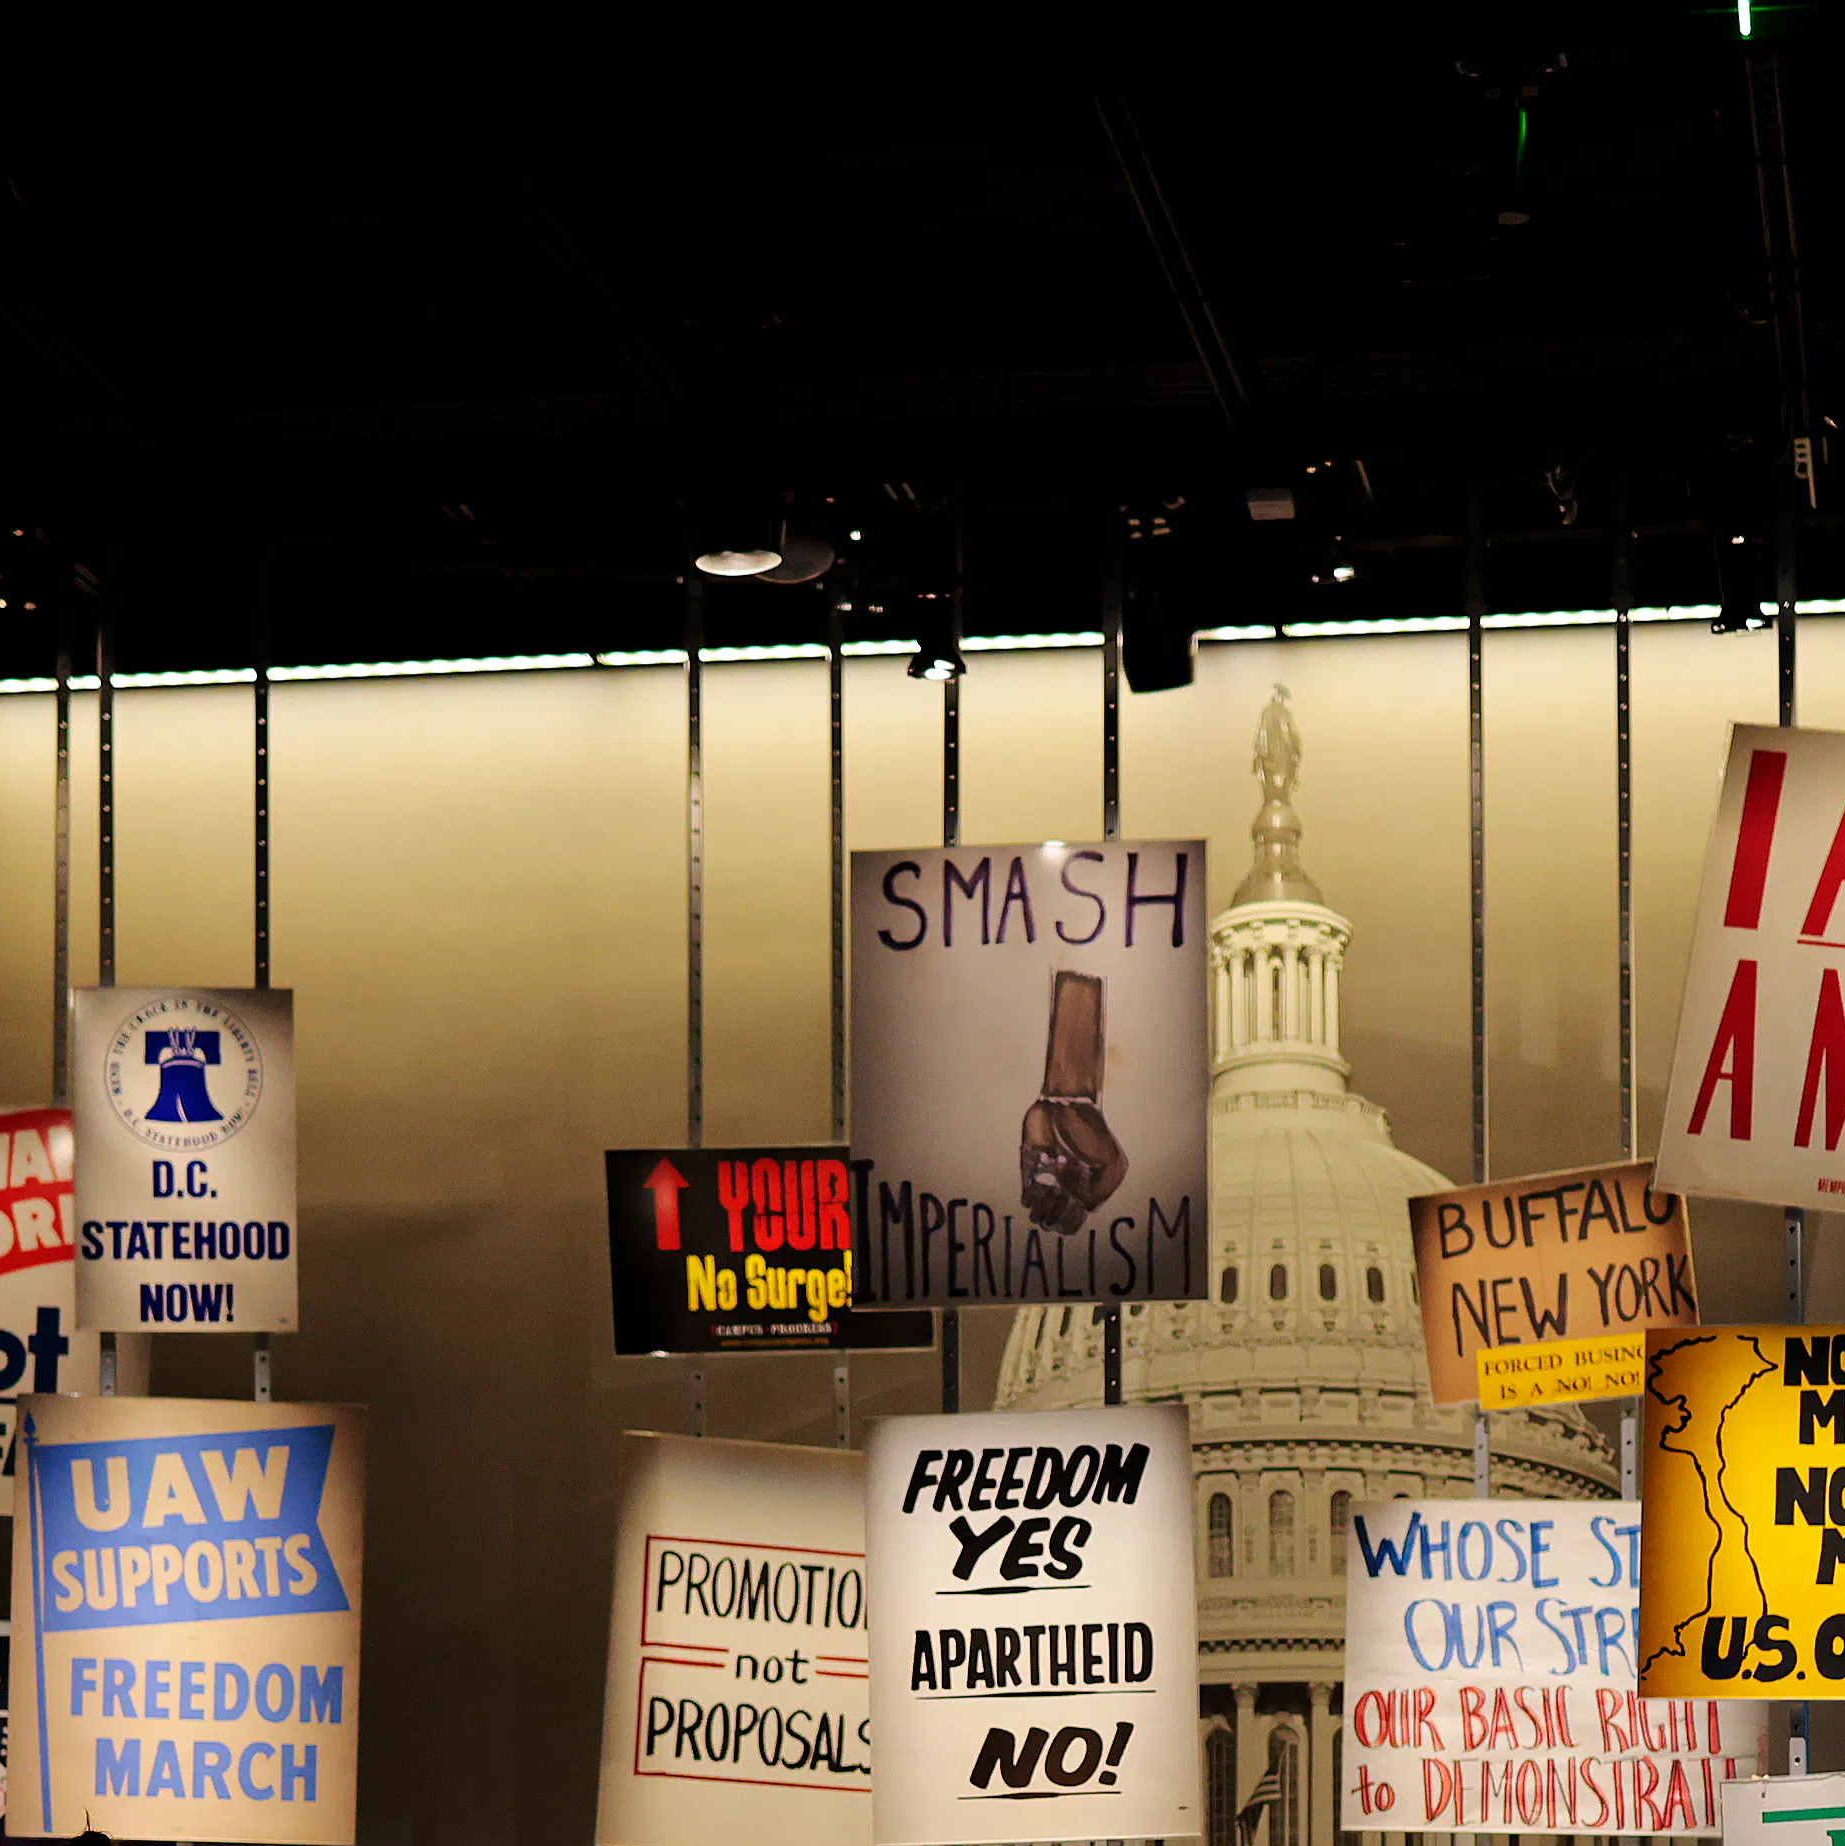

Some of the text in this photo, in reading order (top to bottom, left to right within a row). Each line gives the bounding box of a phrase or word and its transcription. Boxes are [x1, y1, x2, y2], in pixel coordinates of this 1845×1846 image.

[1724, 749, 1787, 930] I
[877, 851, 1188, 951] SMASH
[1687, 959, 1758, 1140] A
[153, 1161, 217, 1198] D.C.
[717, 1157, 851, 1252] YOUR
[82, 1221, 290, 1260] STATEHOOD
[850, 1158, 1191, 1301] IMPERIALISM
[1437, 1179, 1677, 1260] BUFFALO
[140, 1284, 234, 1322] NOW!
[686, 1249, 852, 1323] No Surge!
[1452, 1252, 1696, 1358] NEW YORK
[1484, 1353, 1563, 1376] FORCED
[1500, 1384, 1517, 1400] IS
[1531, 1382, 1544, 1398] A
[70, 1446, 290, 1532] UAW
[902, 1442, 1150, 1513] FREEDOM
[53, 1534, 318, 1612] SUPPORTS
[949, 1515, 1092, 1581] YES
[1354, 1511, 1559, 1588] WHOSE
[656, 1551, 868, 1630] PROMOTIO
[735, 1649, 810, 1685] not
[911, 1622, 1154, 1691] APARTHEID
[1404, 1599, 1524, 1674] OUR
[1700, 1614, 1806, 1682] U.S.
[70, 1657, 343, 1724] FREEDOM
[1354, 1686, 1445, 1752] OUR
[1458, 1685, 1579, 1752] BASIC
[94, 1738, 318, 1803] MARCH
[969, 1721, 1134, 1789] NO!
[1351, 1765, 1395, 1815] to
